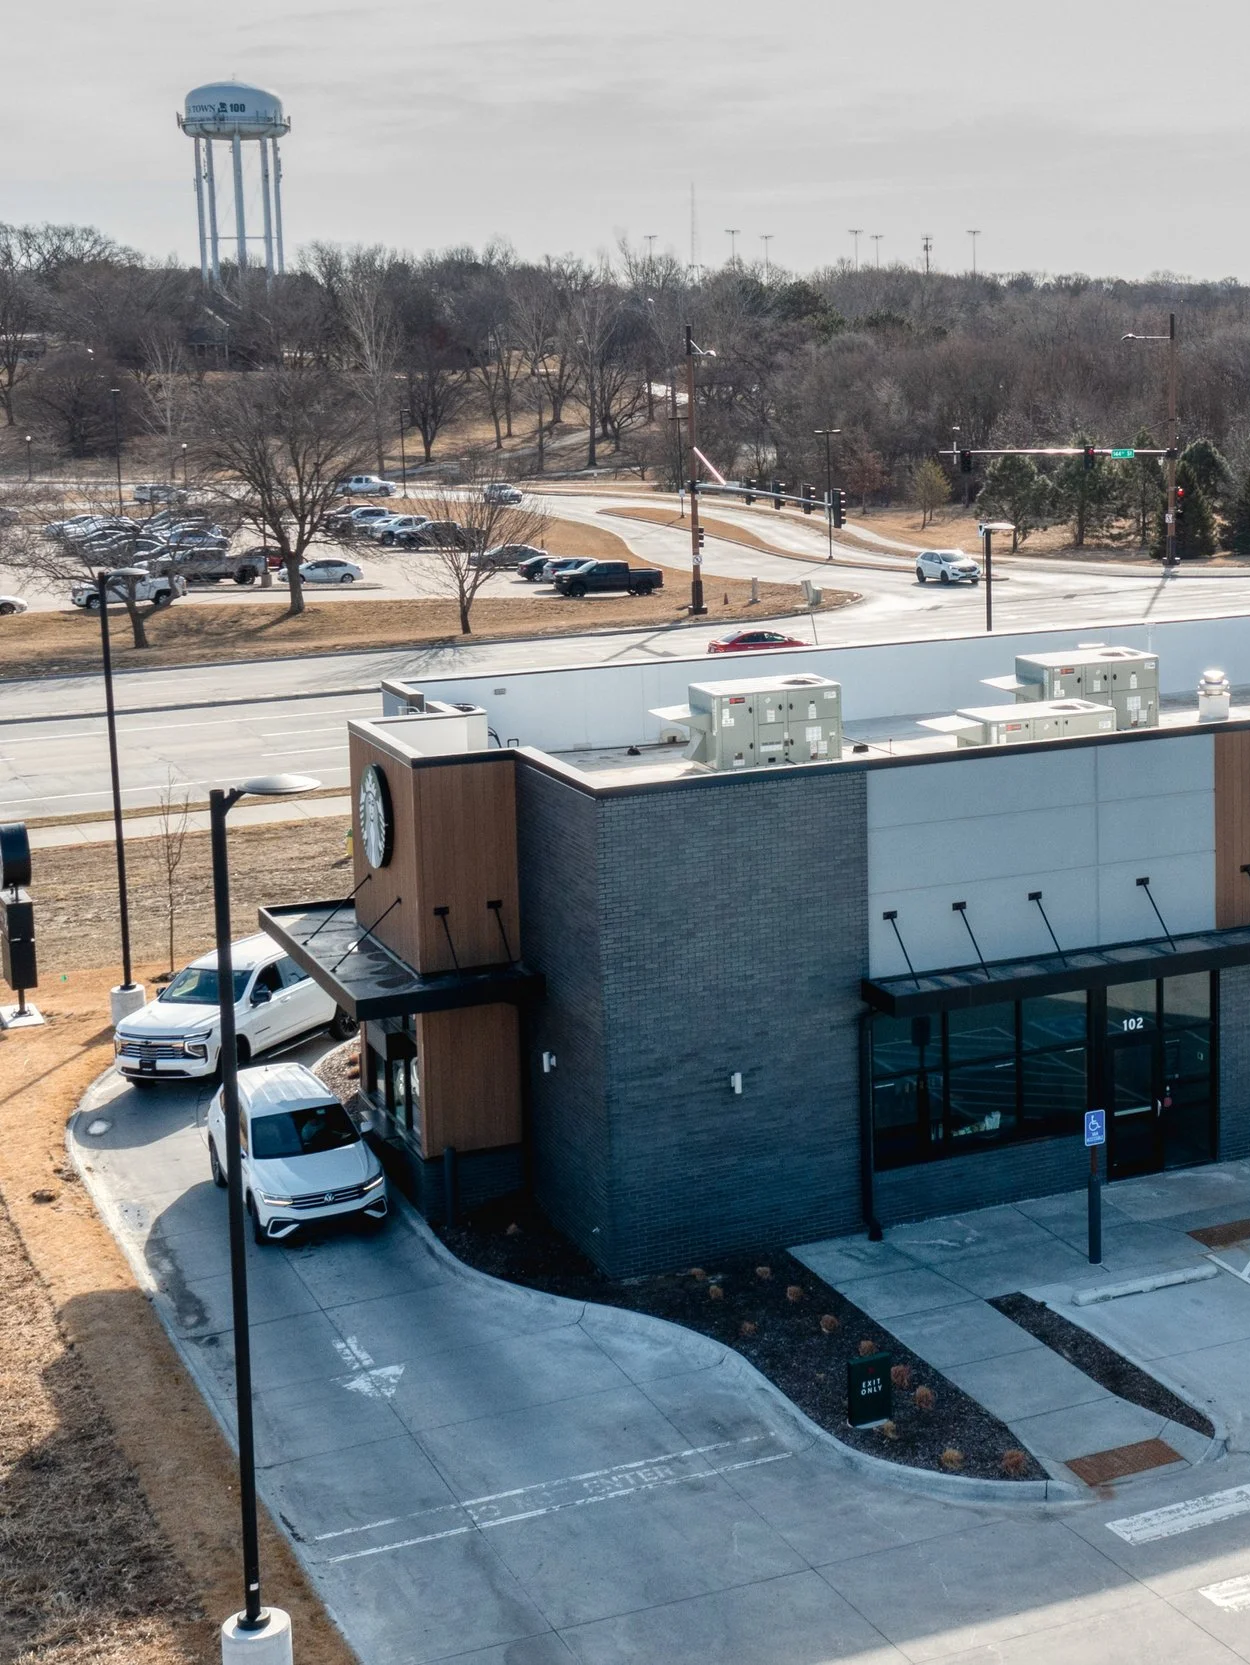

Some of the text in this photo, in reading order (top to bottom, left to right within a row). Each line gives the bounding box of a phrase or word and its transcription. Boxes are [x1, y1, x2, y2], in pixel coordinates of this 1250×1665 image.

[192, 104, 216, 112] TOWN
[230, 104, 246, 112] 100
[1122, 1017, 1144, 1031] 102
[862, 1378, 880, 1388] EXIT
[861, 1384, 882, 1396] ONLY
[582, 1464, 675, 1494] ENTER
